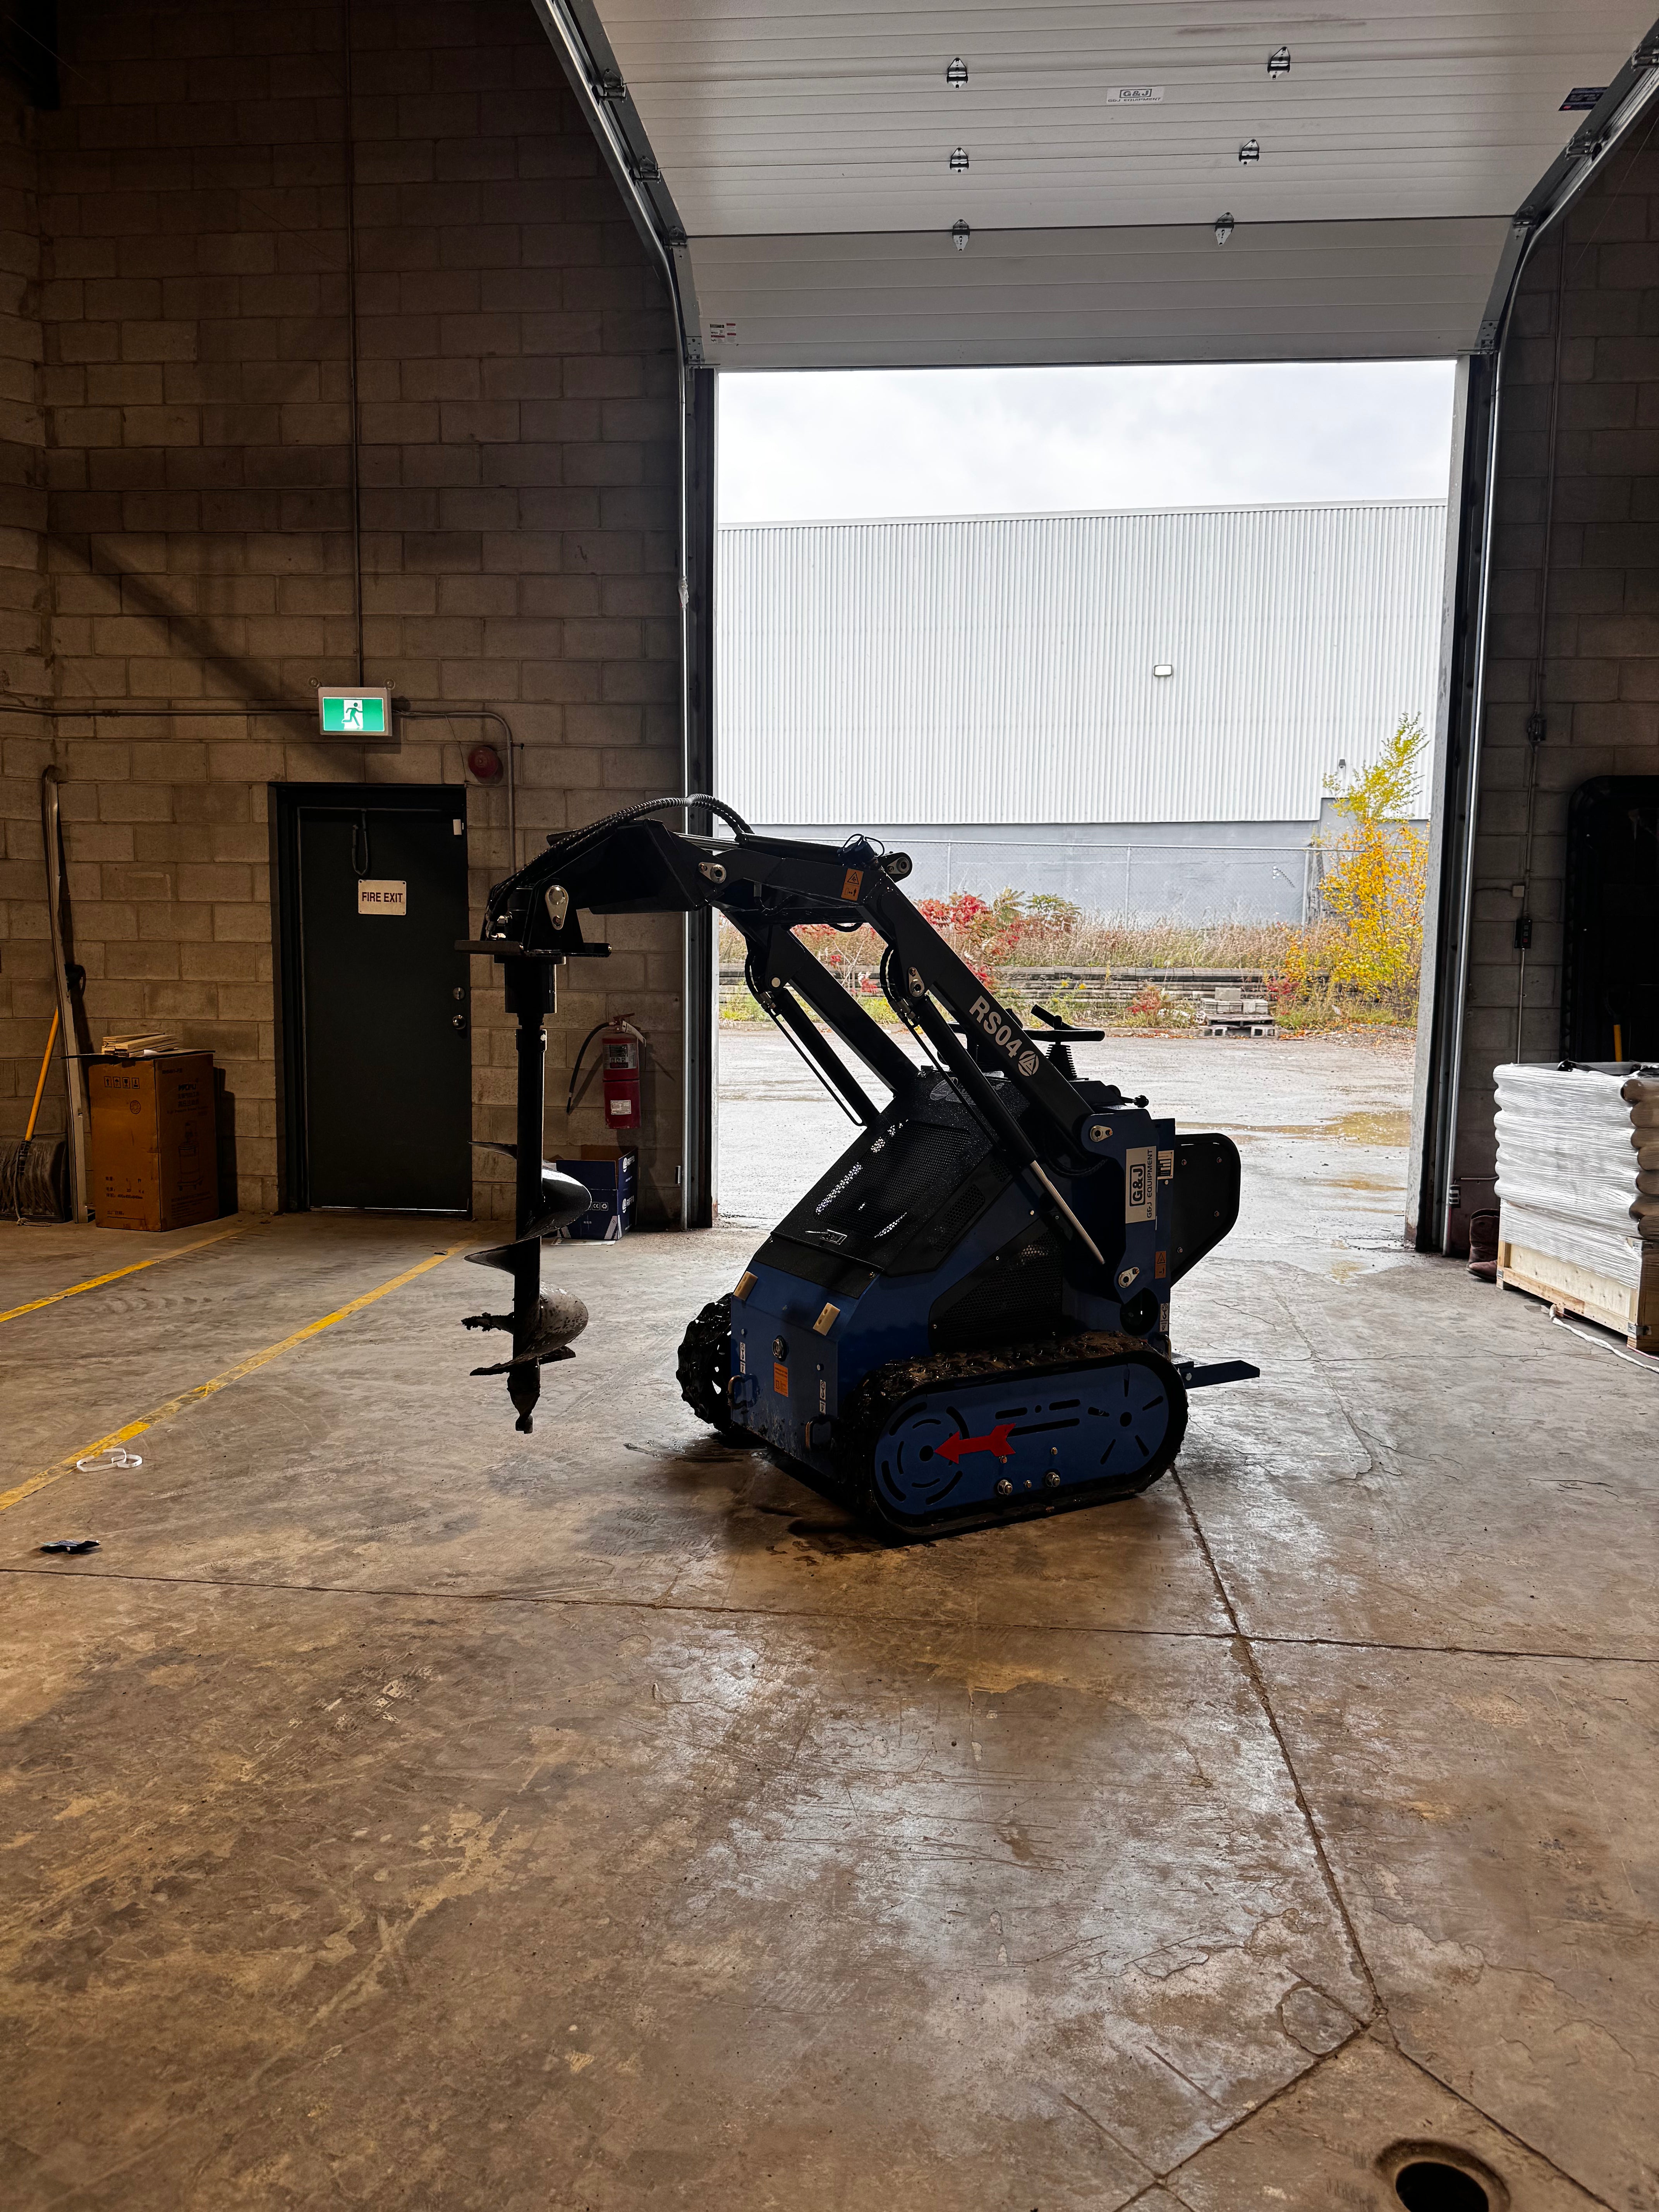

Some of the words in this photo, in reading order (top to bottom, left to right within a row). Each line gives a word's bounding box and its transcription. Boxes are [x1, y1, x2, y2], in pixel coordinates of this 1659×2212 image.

[362, 892, 381, 902] FIRE
[384, 893, 403, 903] EXIT
[969, 995, 1022, 1058] RS04
[1132, 1168, 1143, 1201] G&J
